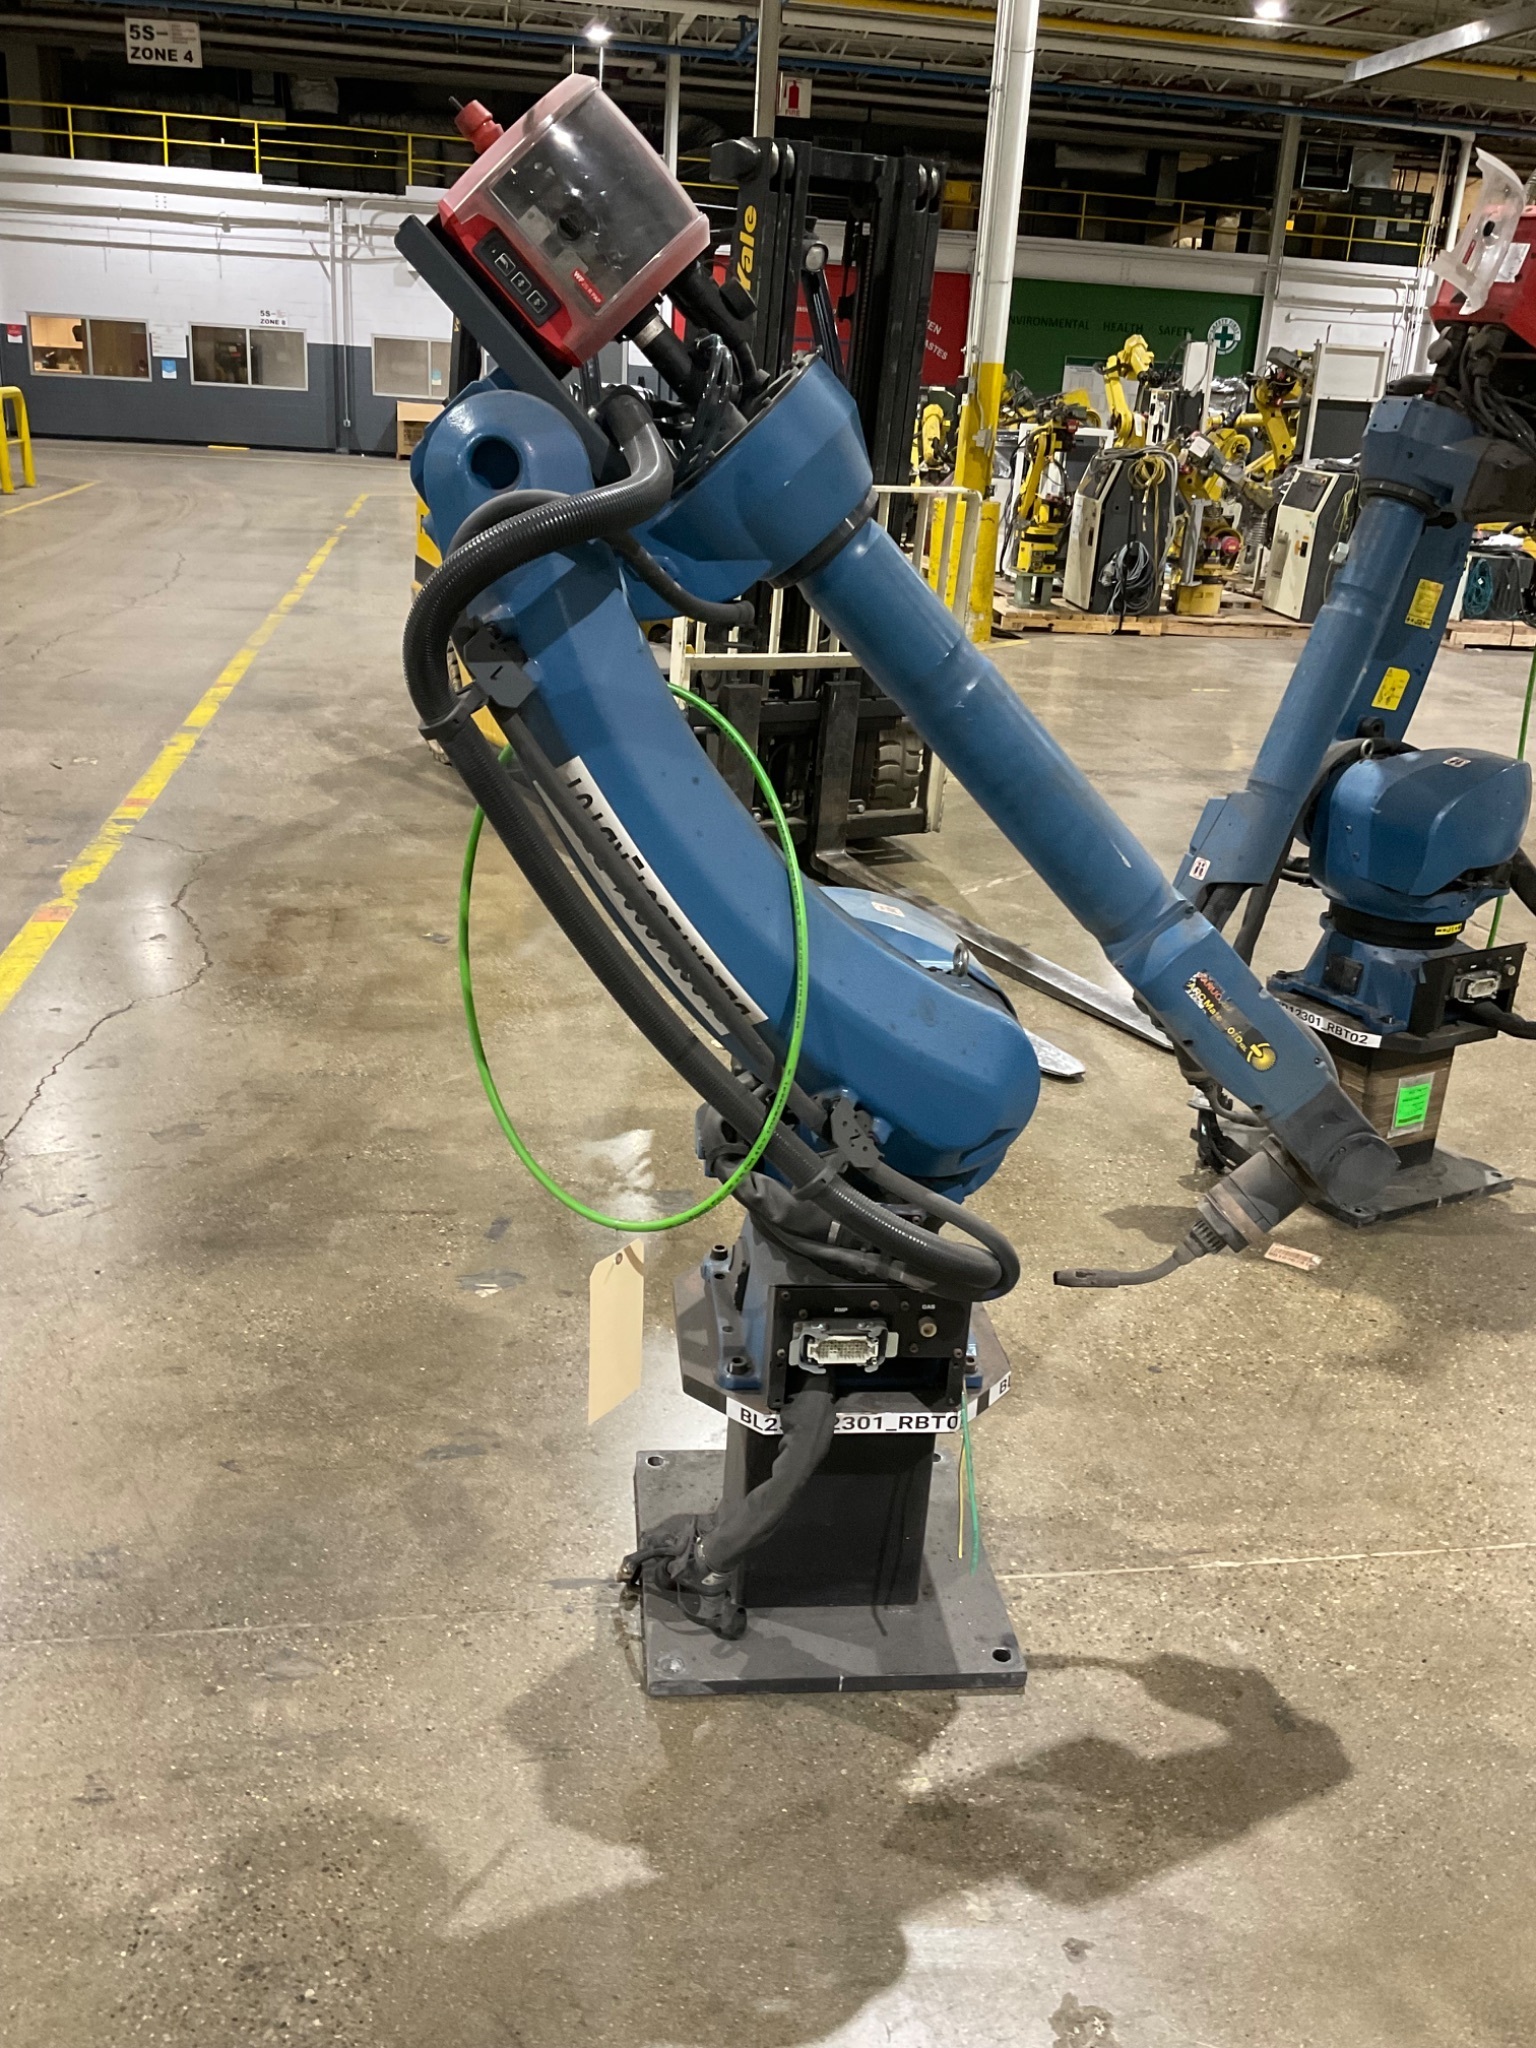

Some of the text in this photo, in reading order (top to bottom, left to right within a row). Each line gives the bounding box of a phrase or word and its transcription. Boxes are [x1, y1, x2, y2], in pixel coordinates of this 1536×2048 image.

[130, 46, 194, 63] ZONE 4
[737, 205, 757, 291] Yale
[1009, 316, 1195, 337] NVIRONMENTAL HEALTH SAFETY
[1187, 981, 1207, 1001] ARC
